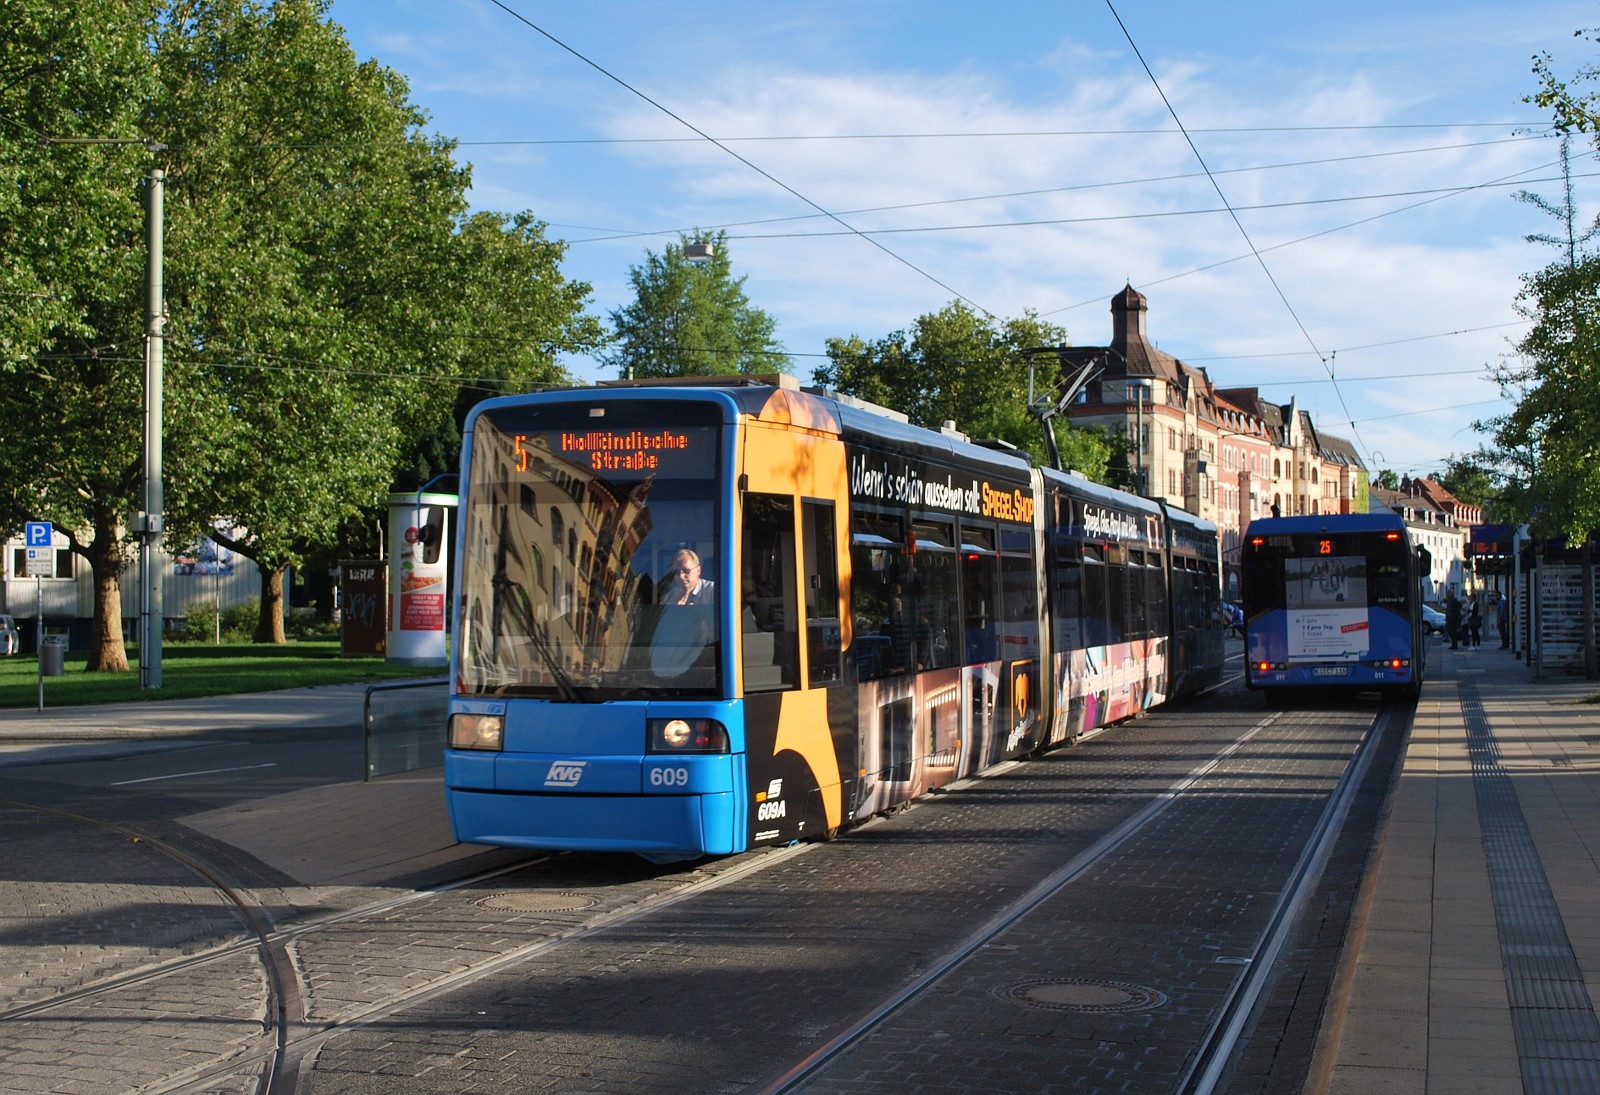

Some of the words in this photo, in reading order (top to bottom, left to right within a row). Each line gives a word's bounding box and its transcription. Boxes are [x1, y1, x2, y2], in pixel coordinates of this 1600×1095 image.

[561, 430, 688, 451] Holländische
[514, 435, 527, 472] 5
[591, 450, 659, 470] Straße
[852, 453, 893, 499] Wenn's
[895, 464, 923, 504] schön
[924, 474, 963, 510] aussehen
[31, 525, 46, 545] P
[1319, 540, 1331, 554] 25
[1374, 671, 1385, 680] 011
[545, 765, 584, 782] KVG
[650, 767, 689, 786] 609
[757, 799, 787, 822] 609A
